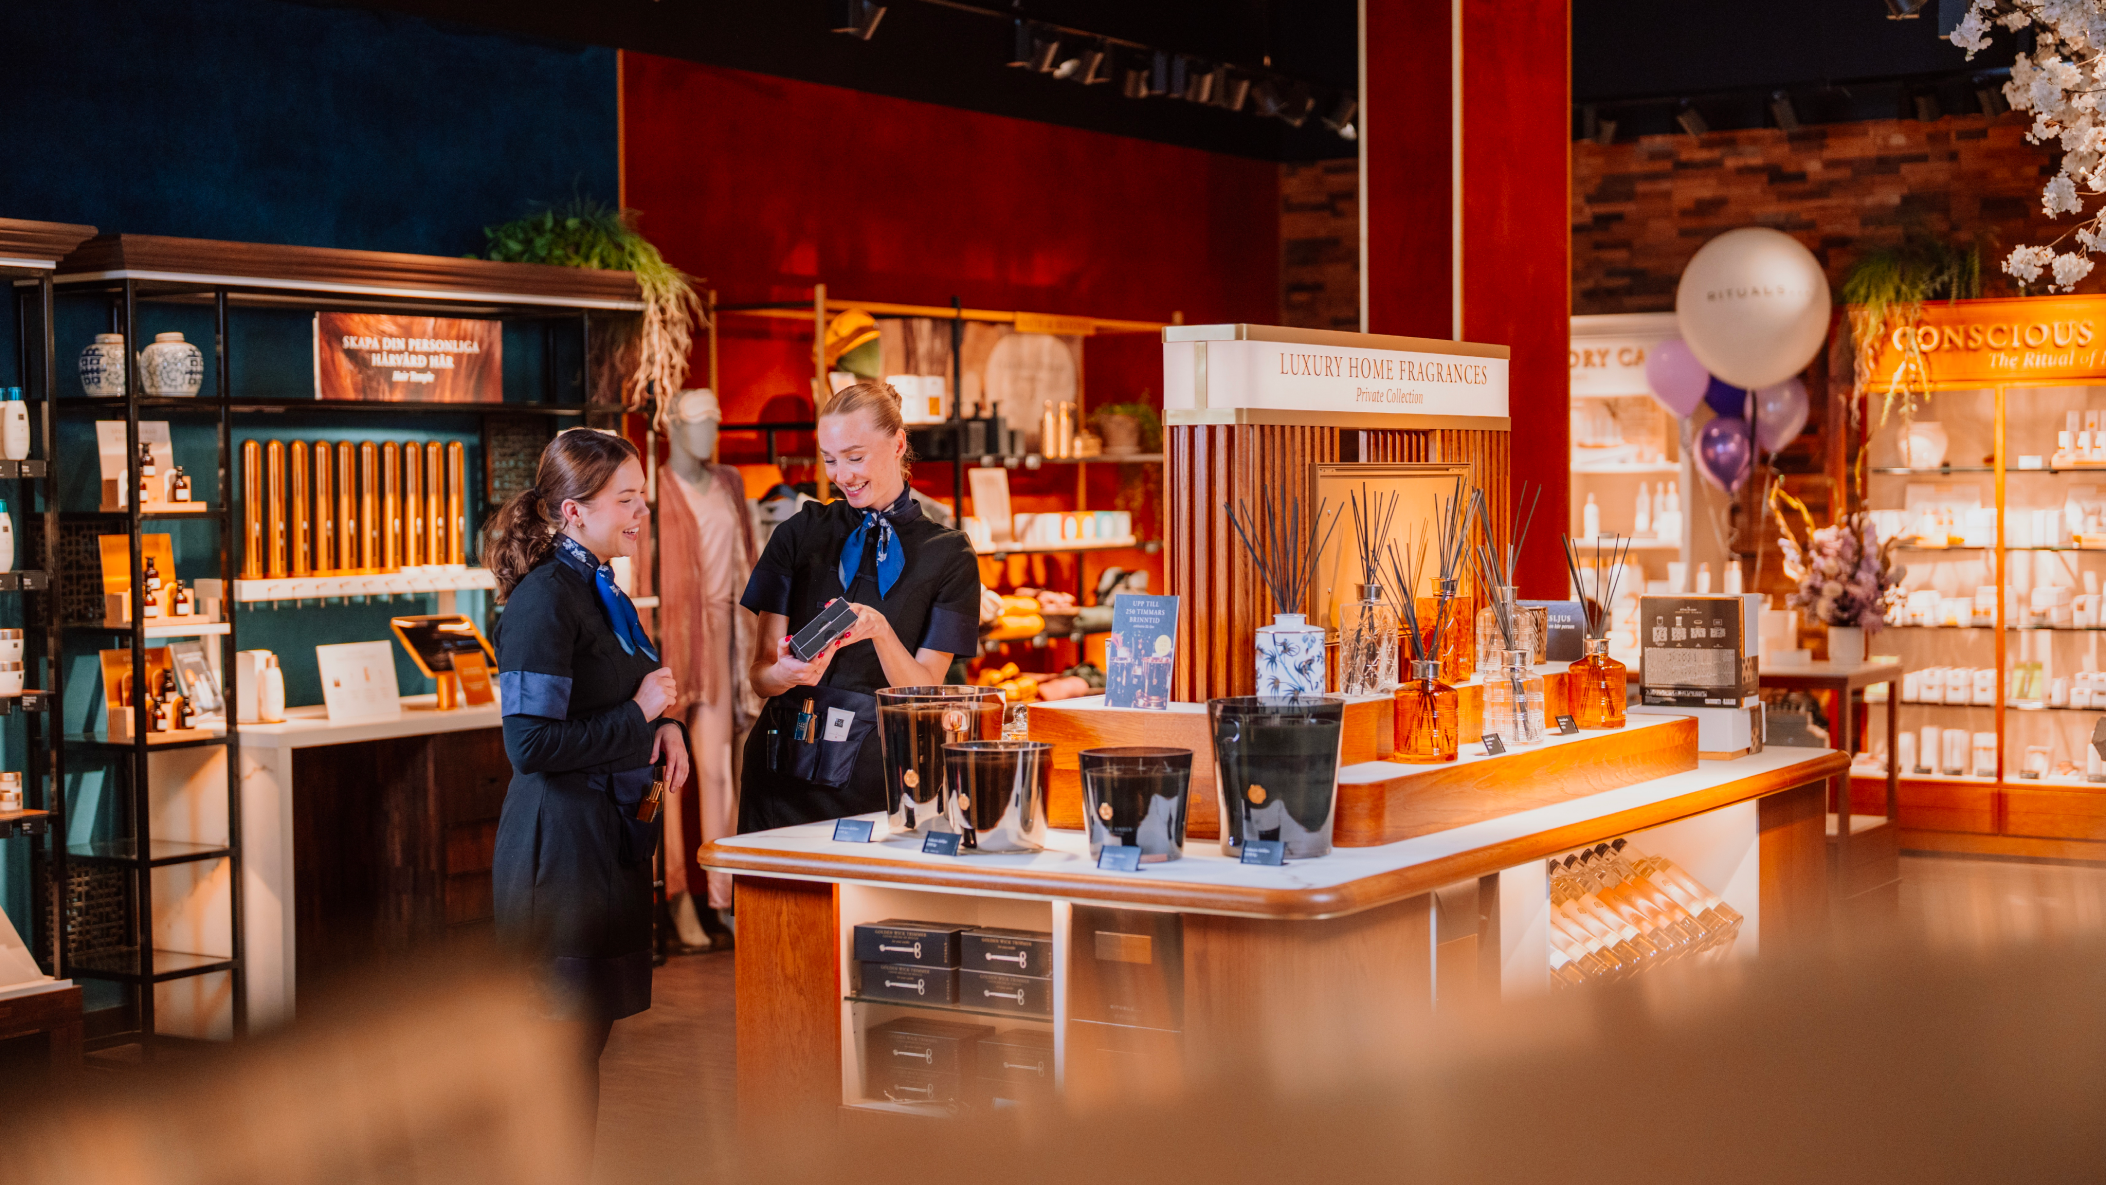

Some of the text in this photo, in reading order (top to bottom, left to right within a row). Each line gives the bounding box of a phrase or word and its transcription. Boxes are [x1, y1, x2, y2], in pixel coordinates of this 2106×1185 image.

[342, 335, 480, 354] SKAPA DIN PERSONLIGA
[1892, 321, 2094, 352] CONSCIOUS
[371, 351, 428, 368] HÅRVÅRD
[1989, 352, 2018, 368] The
[2023, 350, 2075, 368] Ritual
[2080, 349, 2099, 367] of
[1280, 352, 1488, 385] LUXURY HOME FRAGRANCES
[1356, 387, 1424, 405] Private Collection
[1146, 600, 1160, 608] TILL
[1129, 616, 1161, 624] BRINNTID
[1547, 614, 1571, 623] SLJUS
